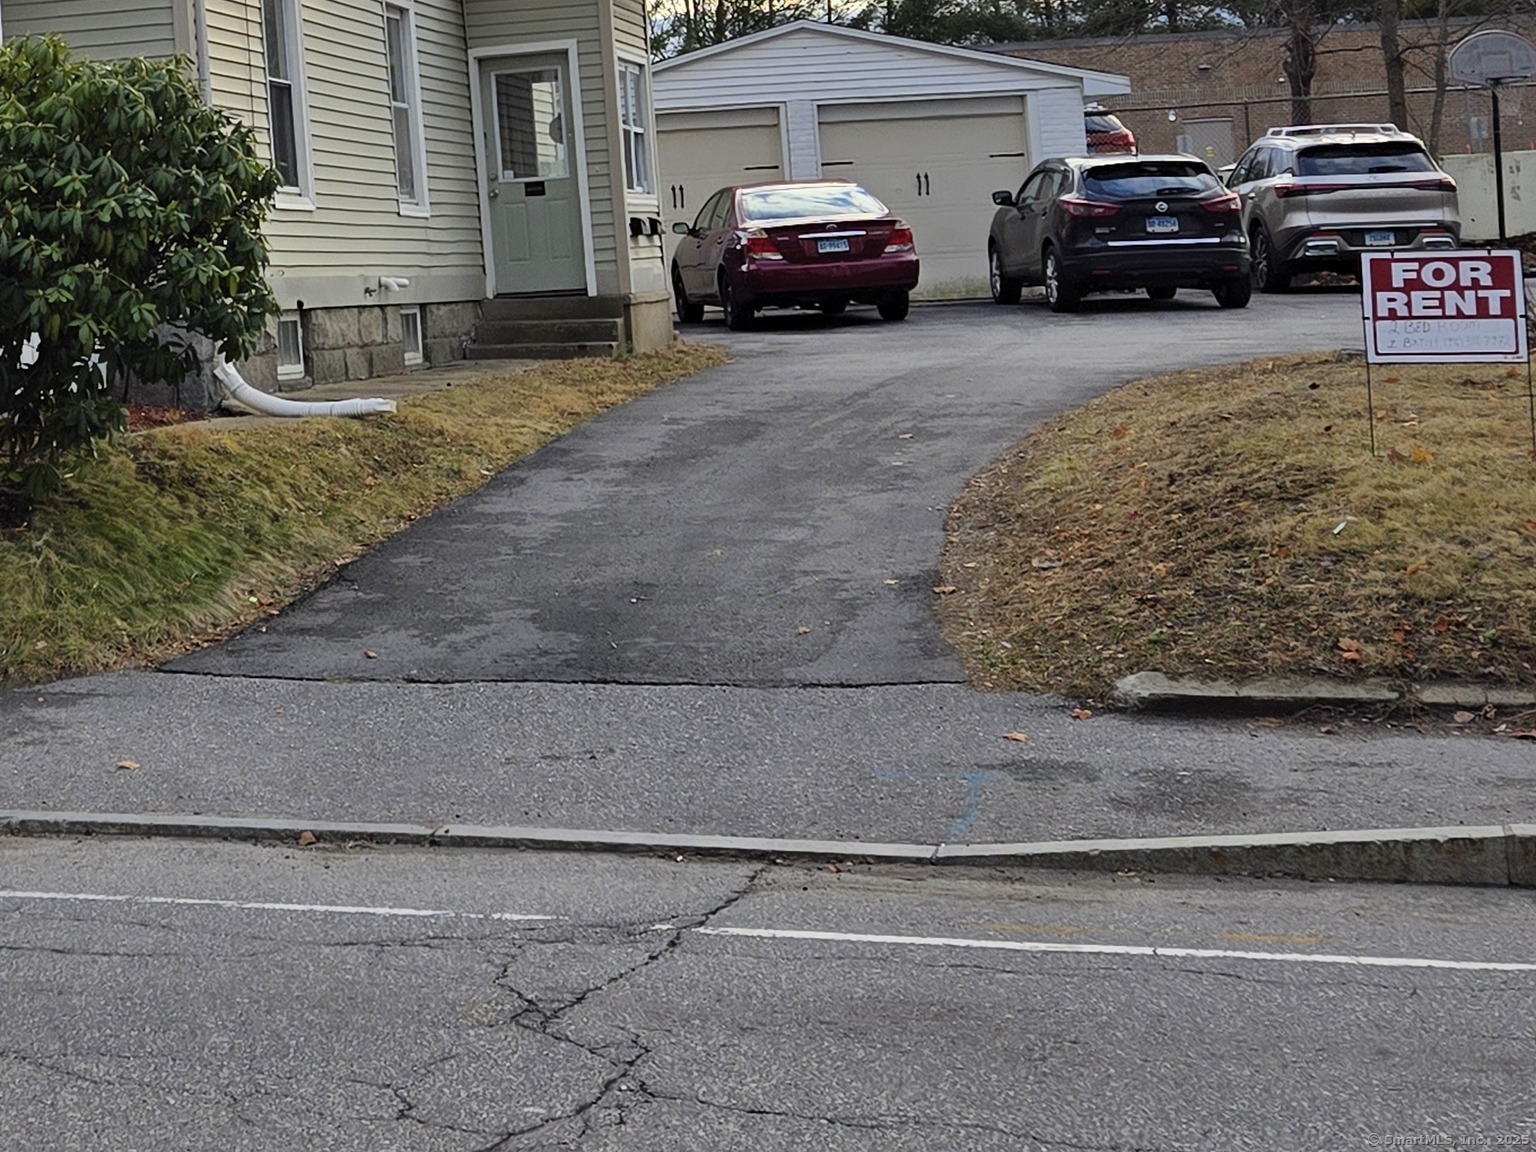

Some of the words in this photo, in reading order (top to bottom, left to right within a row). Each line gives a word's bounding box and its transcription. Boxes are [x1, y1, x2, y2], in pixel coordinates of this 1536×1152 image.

[1391, 260, 1493, 288] FOR
[1376, 289, 1511, 317] RENT
[1404, 321, 1431, 334] BED
